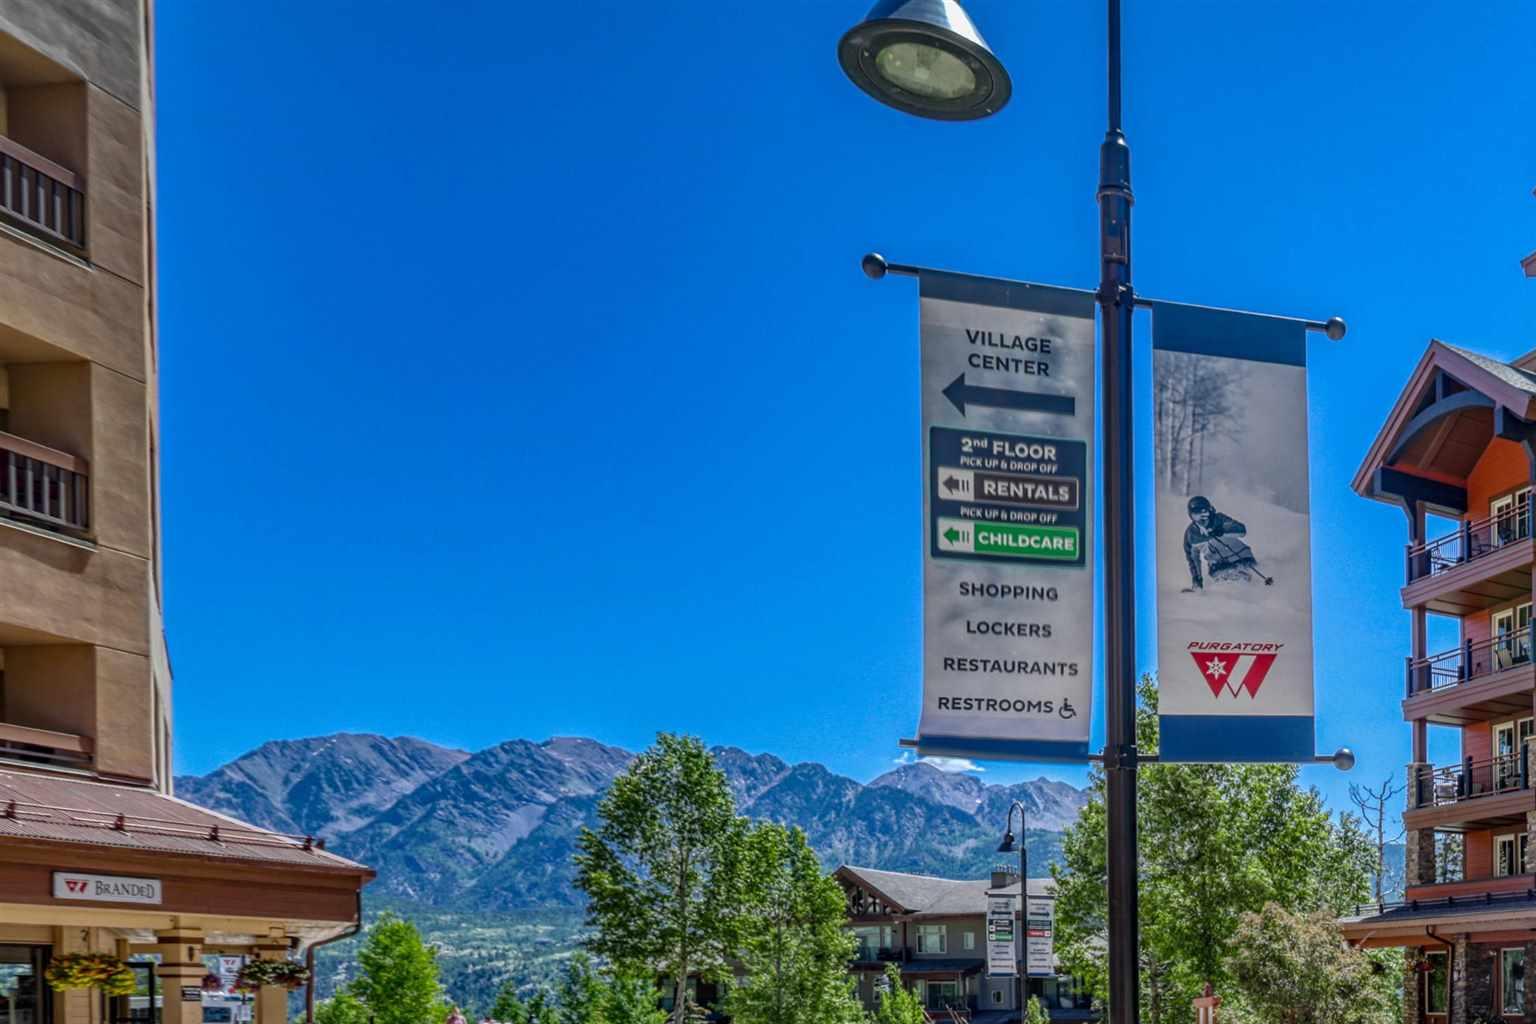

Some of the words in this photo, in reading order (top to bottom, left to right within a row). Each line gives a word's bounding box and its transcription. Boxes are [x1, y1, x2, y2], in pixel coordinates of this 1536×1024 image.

[966, 329, 1052, 354] VILLAGE
[968, 353, 1050, 376] CENTER
[961, 437, 988, 453] 2nd
[992, 441, 1057, 461] FLOOR
[960, 455, 982, 467] PICK
[985, 458, 999, 468] UP
[1000, 460, 1007, 469] &
[1009, 460, 1037, 472] DROP
[1039, 462, 1058, 474] OFF
[983, 479, 1070, 502] RENTALS
[960, 506, 982, 518] PICK
[985, 509, 999, 519] UP
[1000, 511, 1007, 520] &
[1009, 511, 1037, 523] DROP
[1039, 513, 1058, 525] OFF
[978, 531, 1075, 551] CHILDCARE
[959, 581, 1059, 601] SHOPPING
[966, 620, 1053, 638] LOCKERS
[1187, 641, 1284, 652] PURGATORY
[943, 657, 1079, 677] RESTAURANTS
[938, 696, 1054, 713] RESTROOMS
